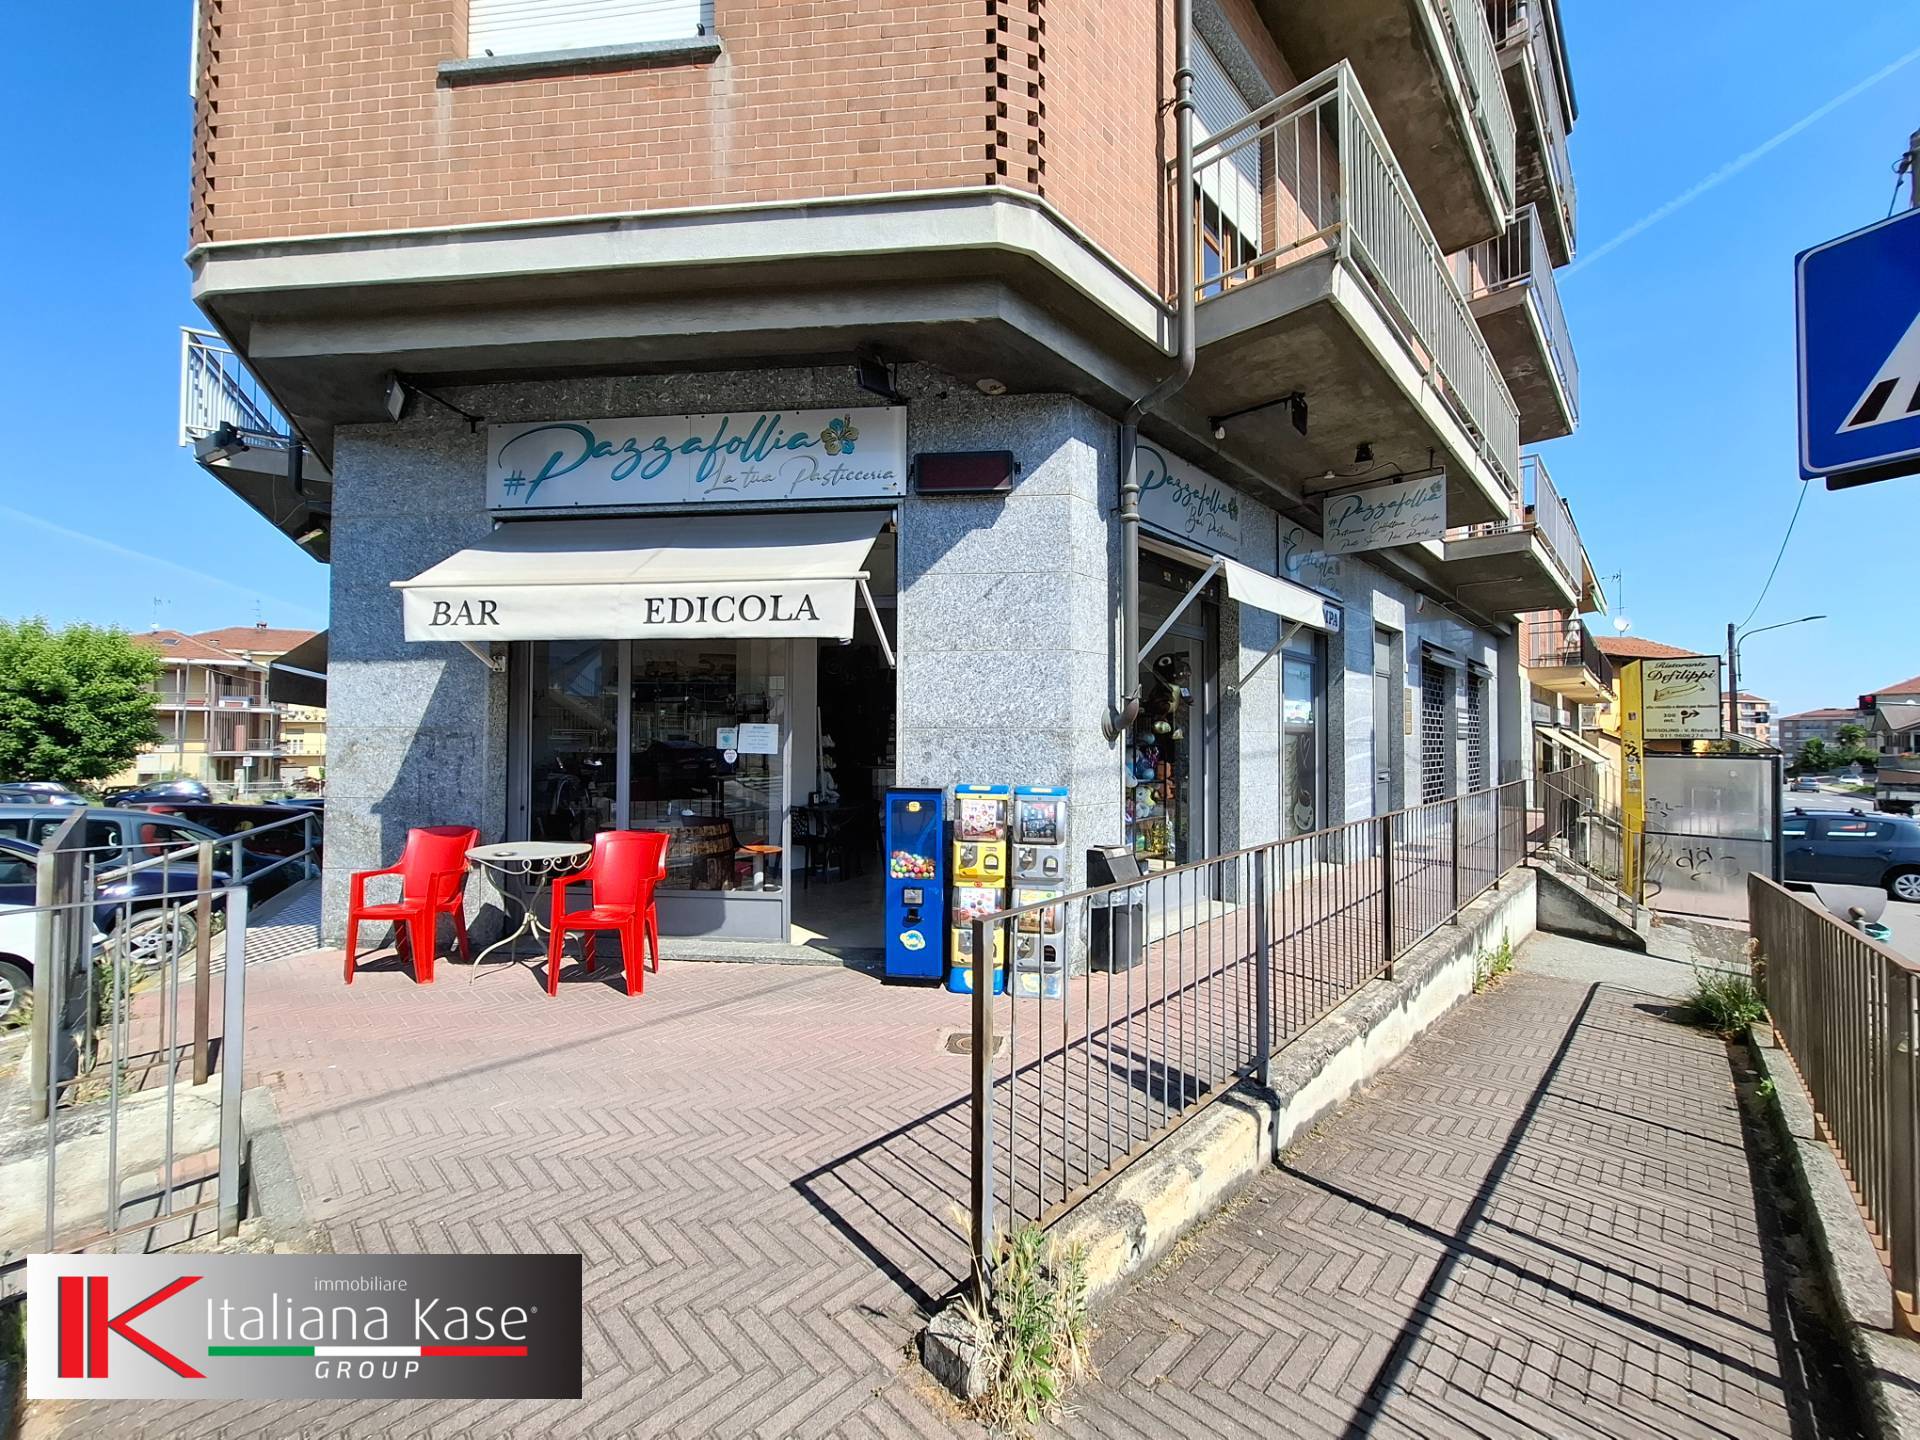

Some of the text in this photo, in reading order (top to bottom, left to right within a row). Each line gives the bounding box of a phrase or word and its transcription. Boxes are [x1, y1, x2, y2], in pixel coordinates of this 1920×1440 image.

[498, 414, 822, 504] #Pazzafollia
[704, 455, 896, 494] La tua Pasticceria
[428, 594, 820, 626] BAR EDICOLA
[1646, 669, 1716, 684] Defilippi
